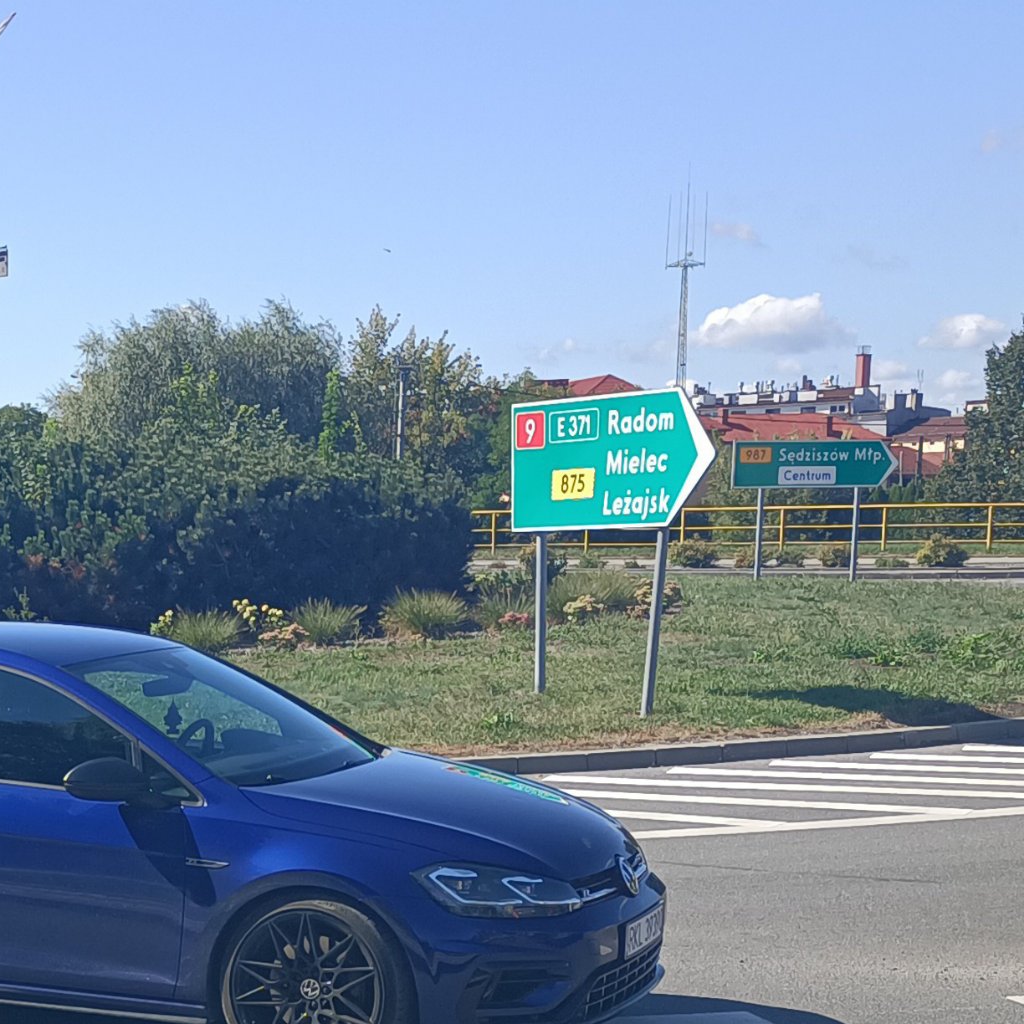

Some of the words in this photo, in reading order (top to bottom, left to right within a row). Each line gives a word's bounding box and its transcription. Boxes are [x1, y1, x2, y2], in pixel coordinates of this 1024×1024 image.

[525, 418, 536, 444] 9
[557, 416, 566, 437] E
[568, 414, 591, 436] 371
[607, 406, 675, 435] Radom
[605, 447, 669, 476] Mielec
[745, 449, 766, 461] 987
[778, 447, 850, 465] Sędziszów
[854, 447, 886, 465] Młp.
[560, 473, 585, 494] 875
[783, 469, 832, 481] Centrum
[602, 487, 670, 521] Leżajsk
